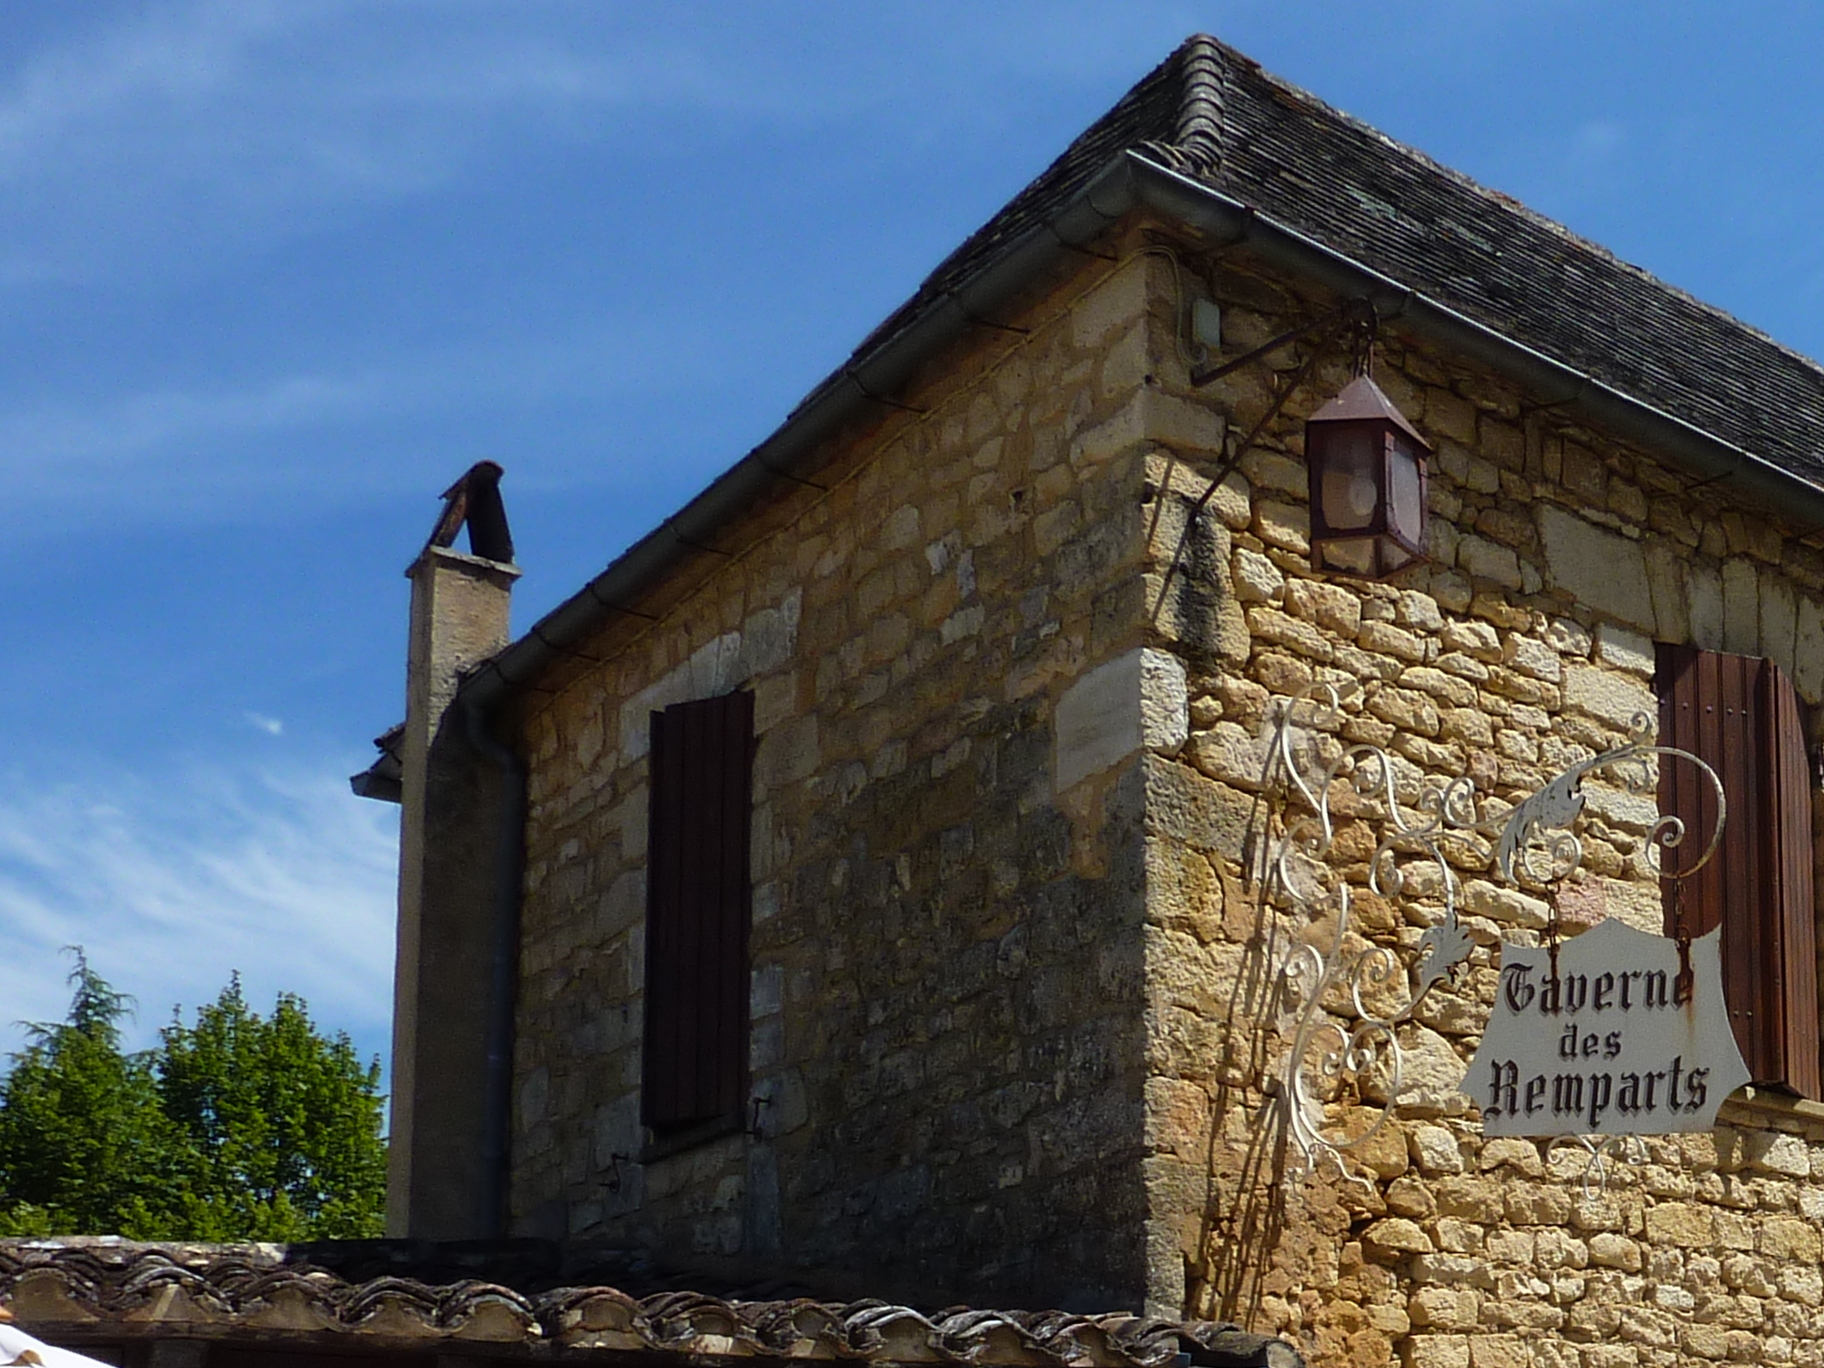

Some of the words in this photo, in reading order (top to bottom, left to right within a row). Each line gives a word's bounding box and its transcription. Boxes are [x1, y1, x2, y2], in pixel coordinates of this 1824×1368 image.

[1501, 962, 1694, 1016] Taverne
[1559, 1021, 1623, 1061] des
[1484, 1055, 1711, 1130] Remparts
